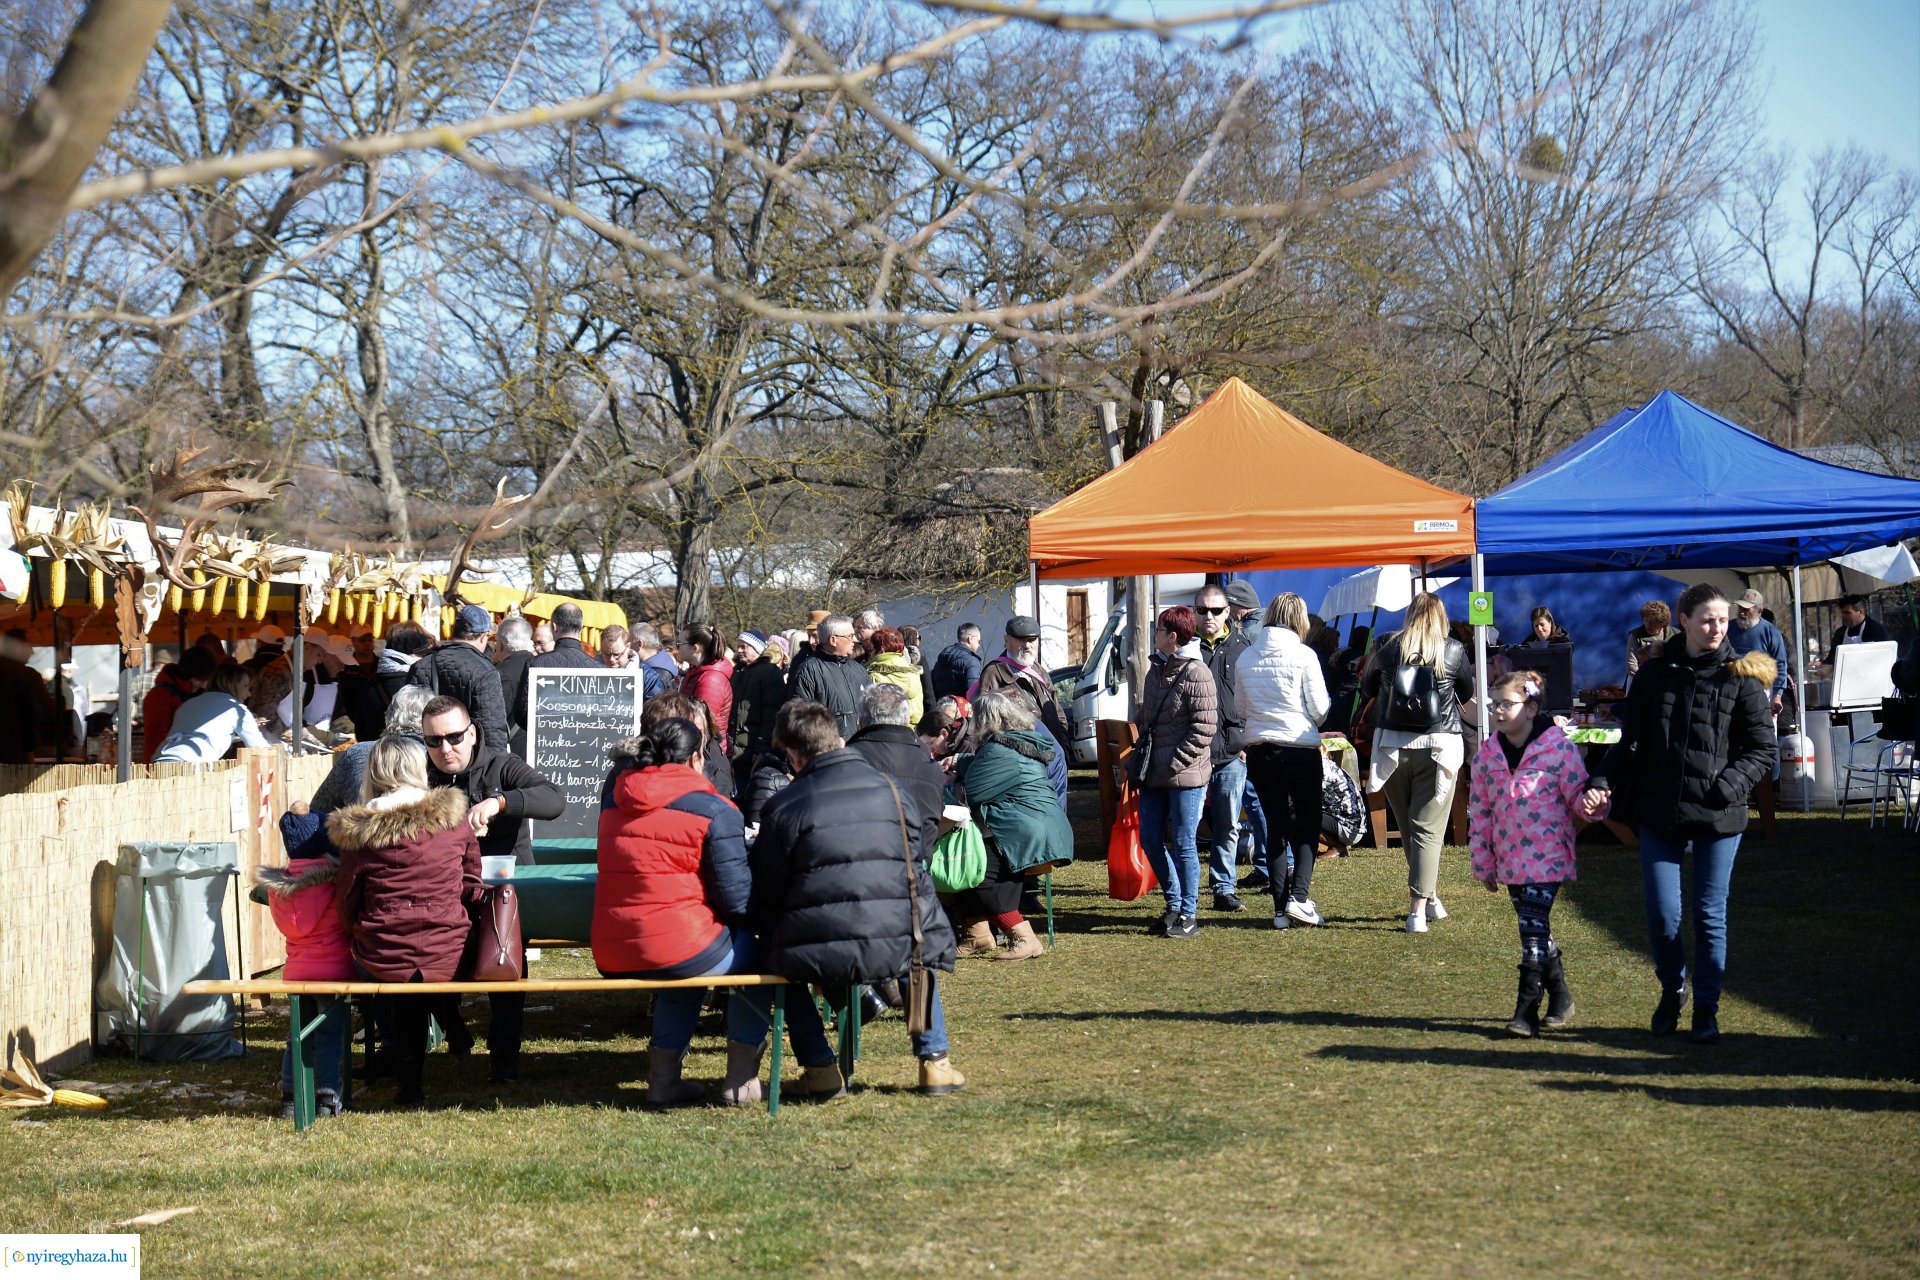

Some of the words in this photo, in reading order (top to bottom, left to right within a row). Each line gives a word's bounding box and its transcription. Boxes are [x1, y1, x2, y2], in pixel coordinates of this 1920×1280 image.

[559, 676, 629, 695] KÍNÁLAT
[589, 737, 599, 748] 1
[536, 752, 582, 768] Kolbász
